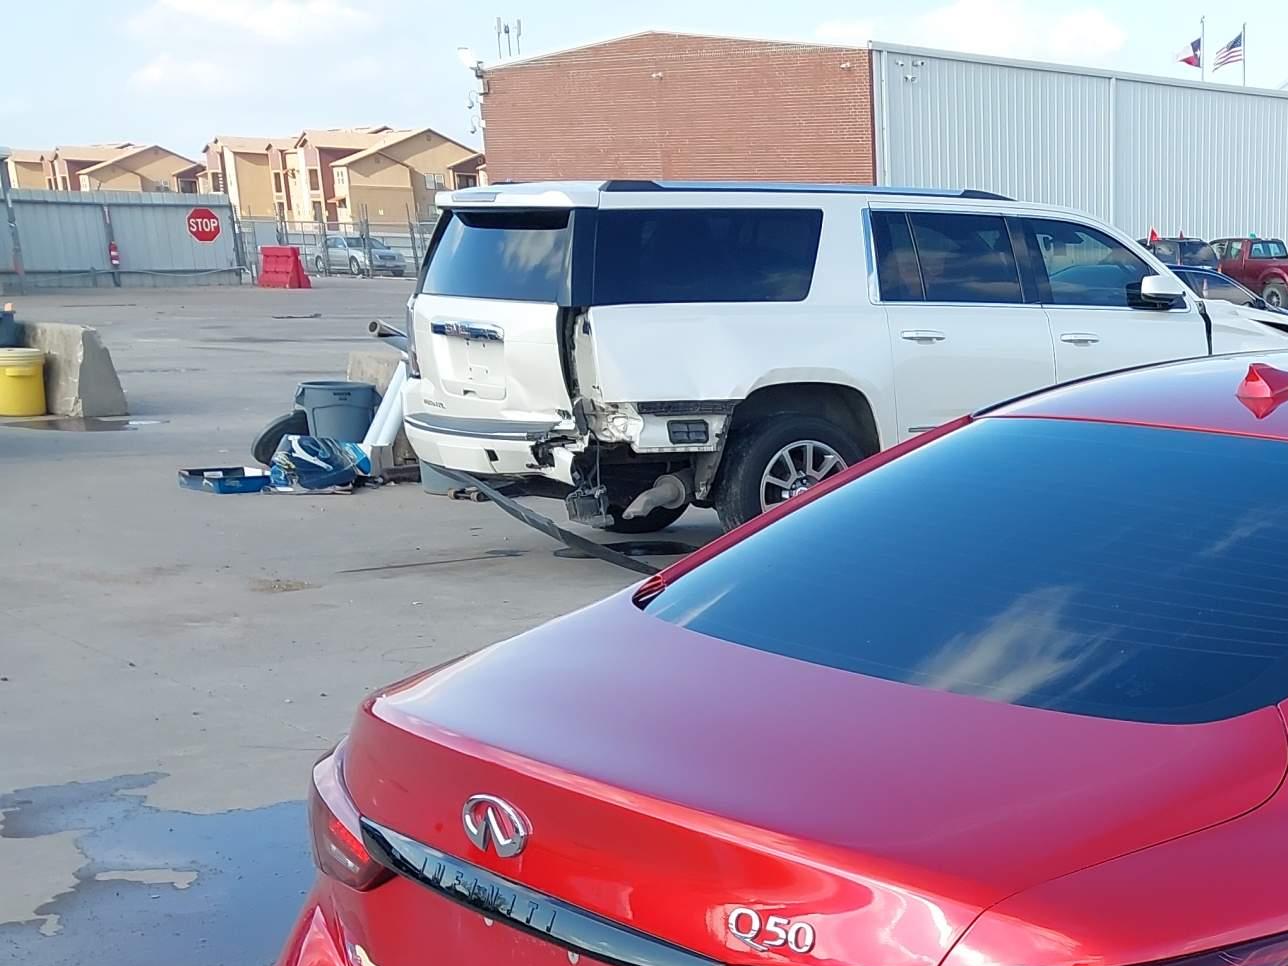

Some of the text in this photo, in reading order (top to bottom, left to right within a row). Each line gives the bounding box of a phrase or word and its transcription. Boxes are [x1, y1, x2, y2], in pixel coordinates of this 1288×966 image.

[189, 218, 218, 232] STOP
[417, 857, 557, 932] INFINITI
[727, 906, 816, 954] Q50
